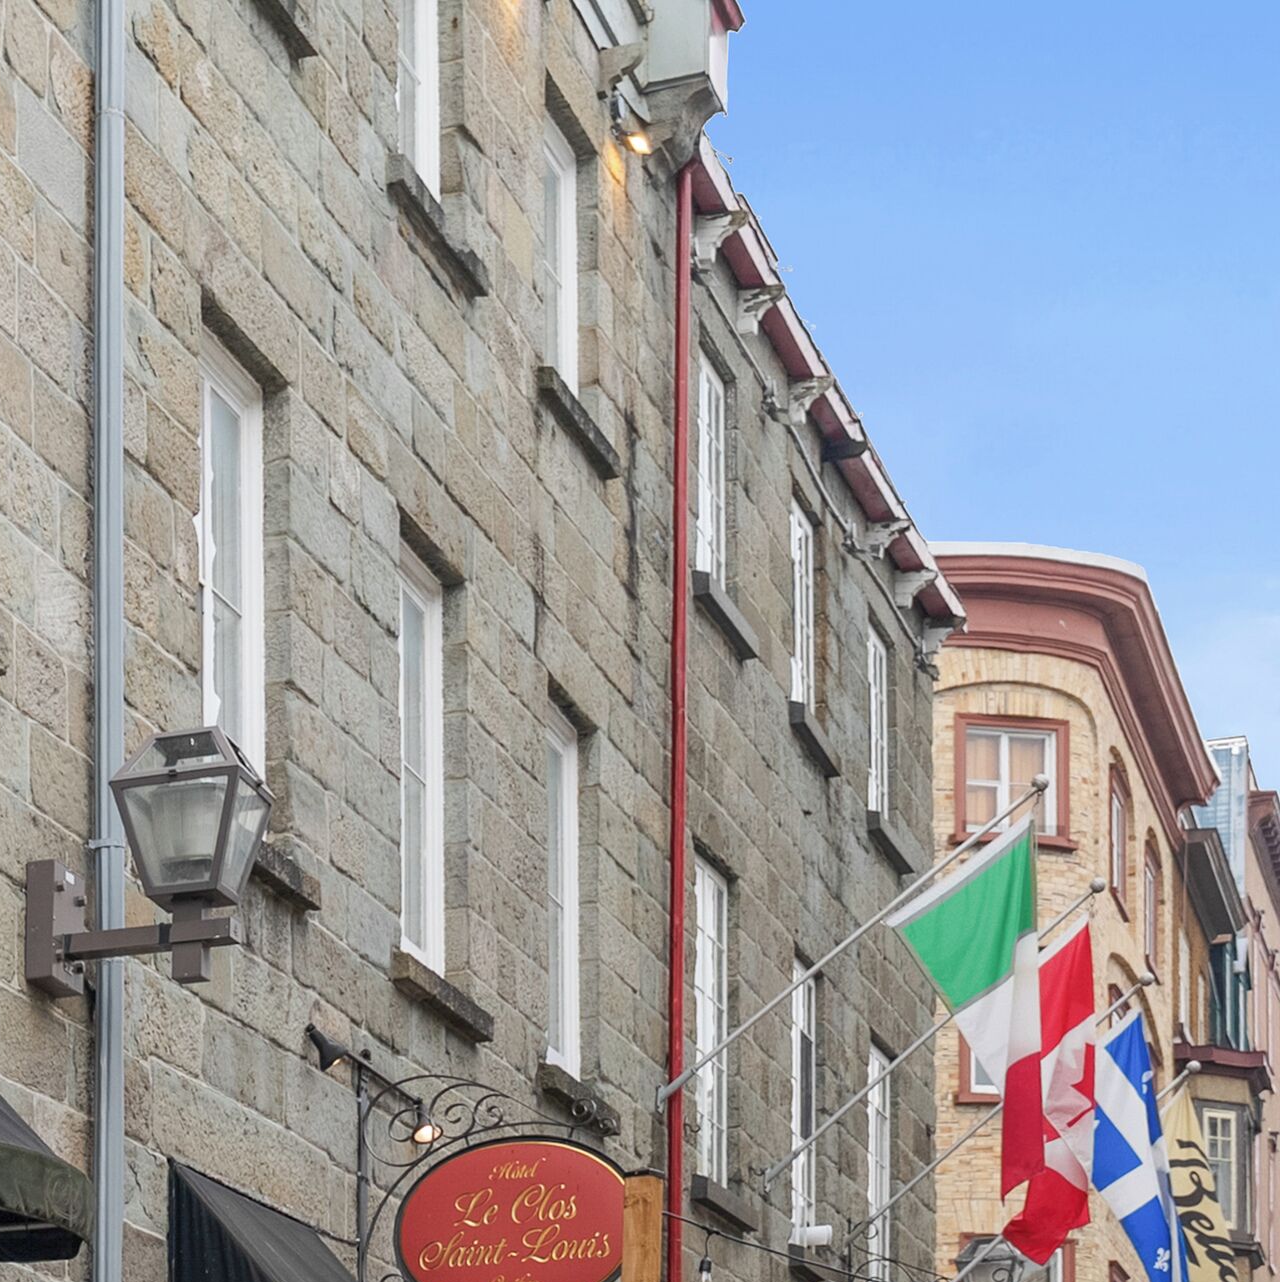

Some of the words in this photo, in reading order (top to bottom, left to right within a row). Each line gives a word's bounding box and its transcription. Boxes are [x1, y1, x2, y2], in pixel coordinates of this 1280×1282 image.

[488, 1157, 547, 1181] Hôtel
[454, 1188, 499, 1227] Le
[511, 1183, 577, 1224] Clos
[419, 1224, 611, 1271] Saint-Louis
